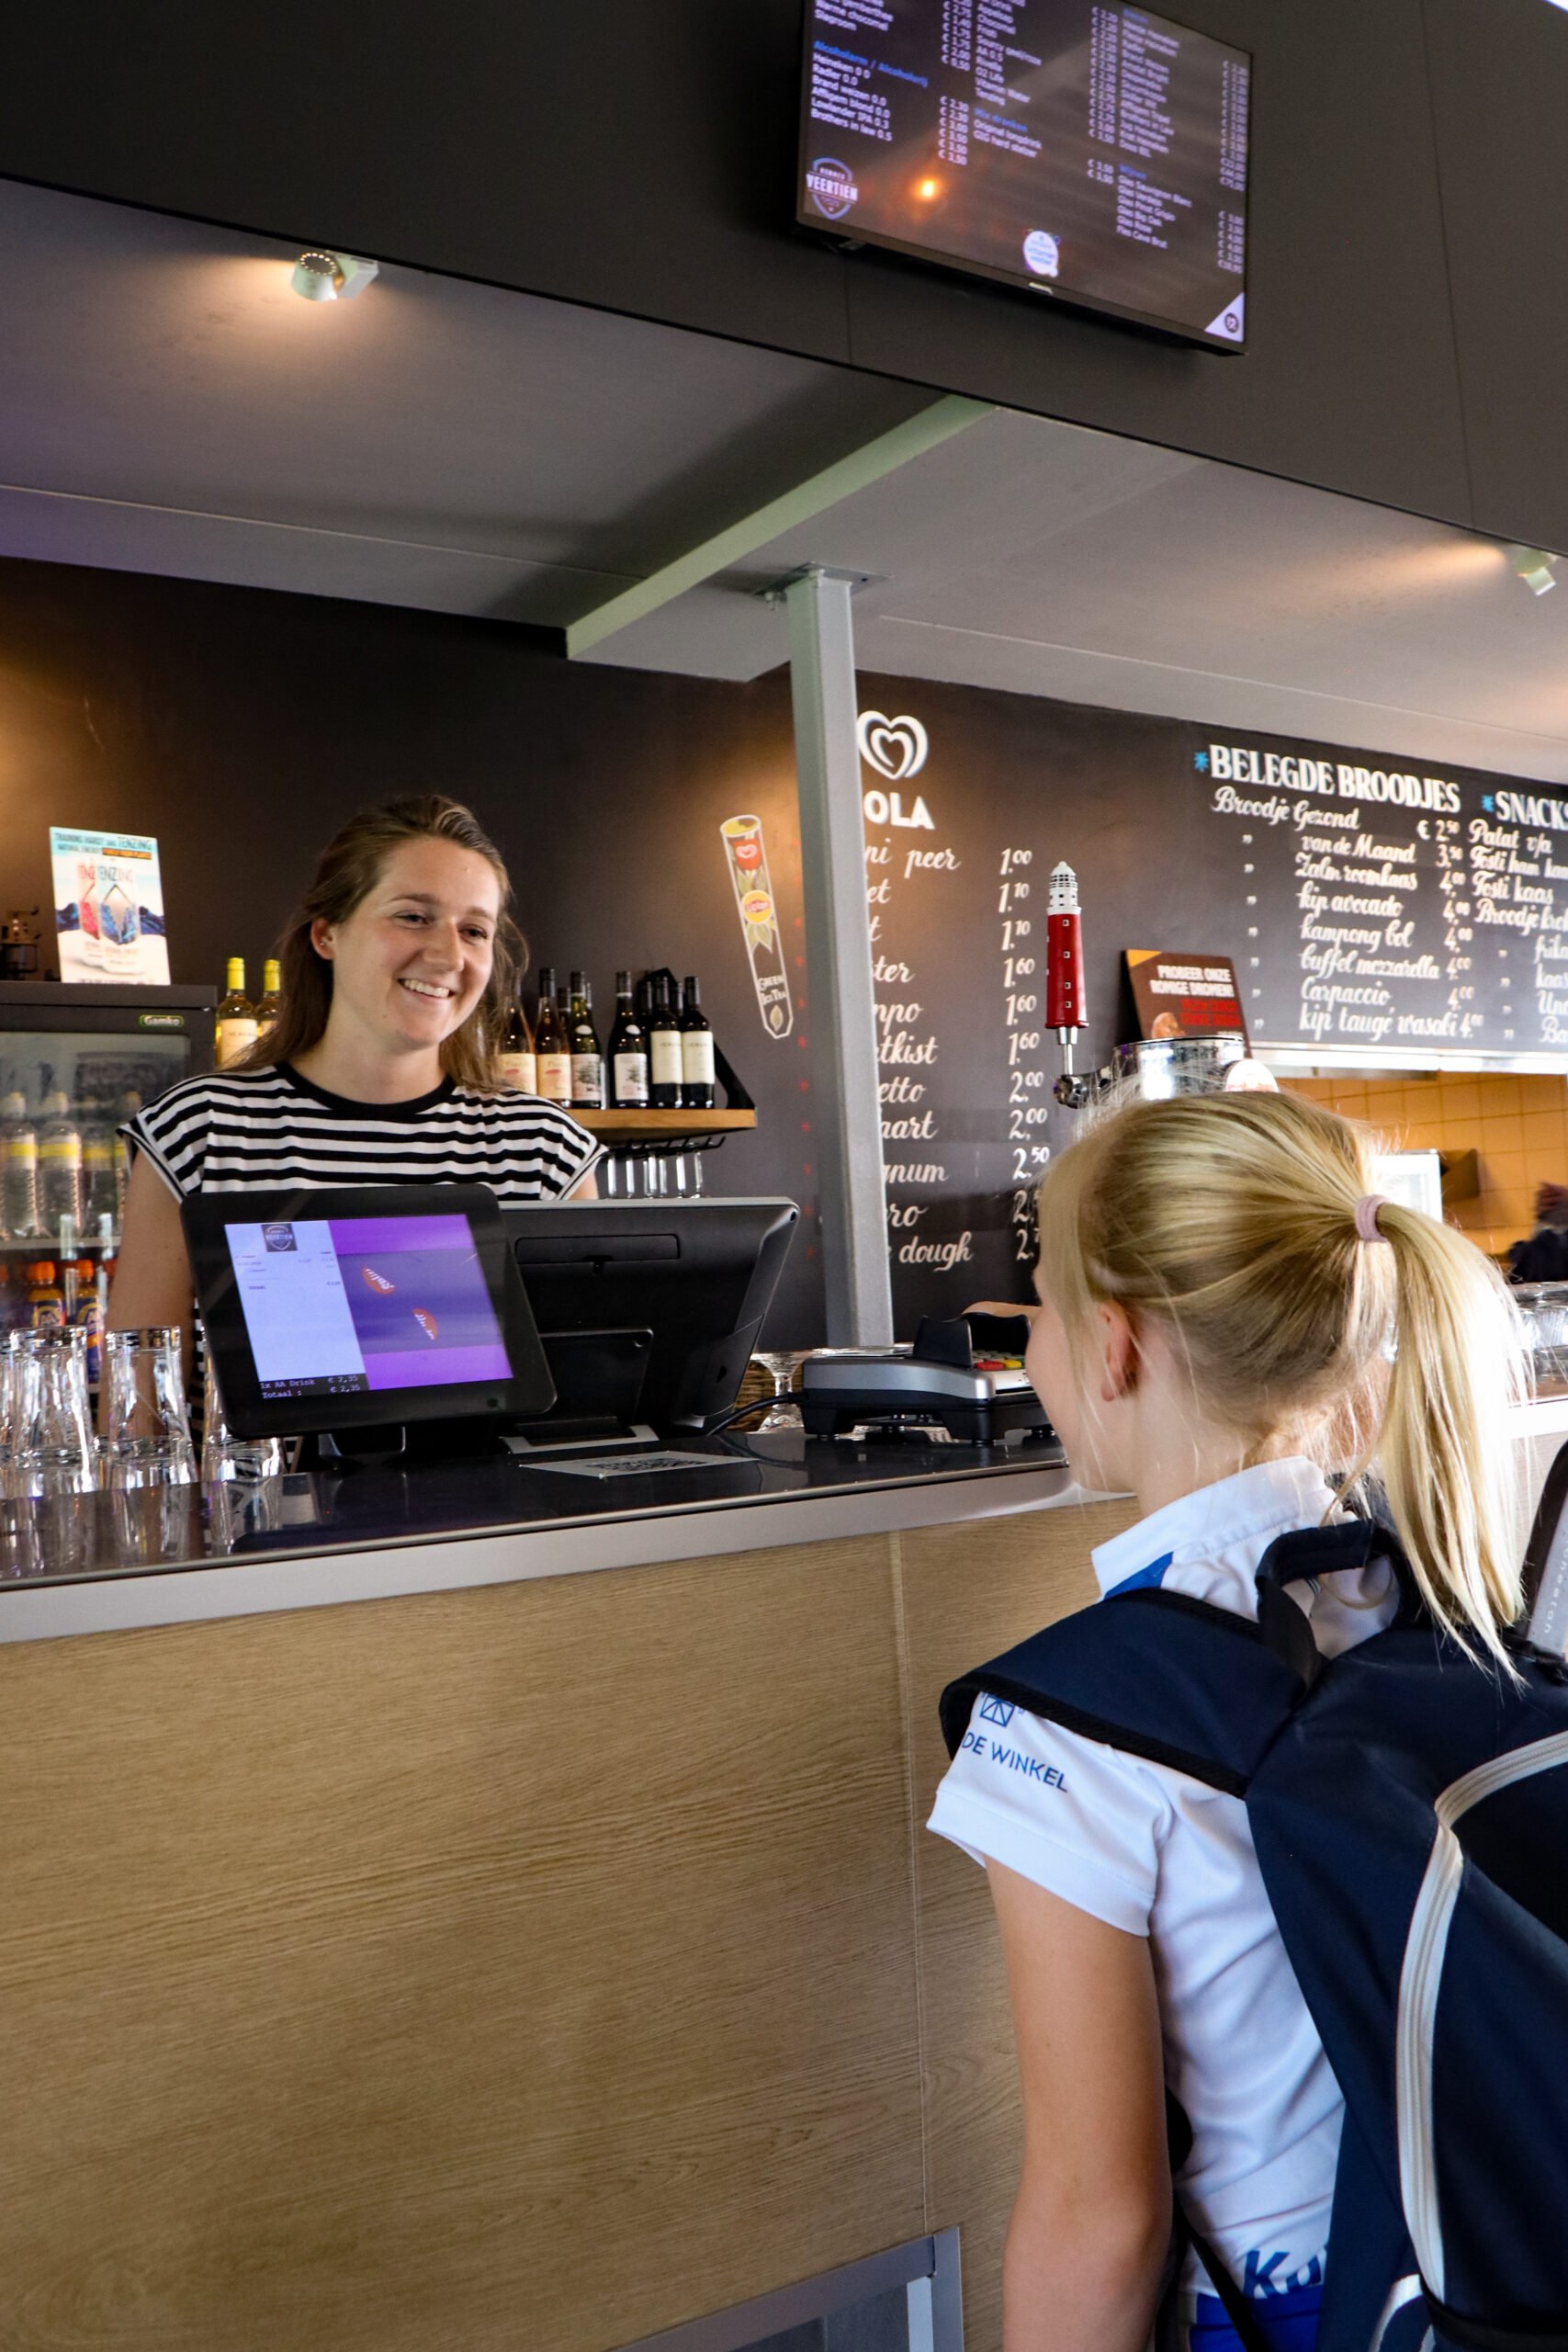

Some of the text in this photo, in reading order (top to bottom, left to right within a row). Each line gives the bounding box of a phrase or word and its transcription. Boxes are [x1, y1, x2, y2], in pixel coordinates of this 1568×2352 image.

[807, 173, 858, 201] VEERTIEN
[1210, 744, 1461, 813] BELEGDE BROODJES
[1210, 786, 1430, 840] Broodje Gezond €
[118, 836, 152, 851] TENZING
[1301, 835, 1332, 852] van
[1334, 837, 1351, 854] de
[1352, 833, 1416, 864] Maand
[1468, 819, 1519, 849] Patat
[904, 848, 963, 879] peer
[1294, 852, 1342, 880] Zalm
[1343, 862, 1417, 890] roomkaas
[1470, 845, 1508, 871] Tosti
[1296, 880, 1328, 918] kip
[1332, 894, 1404, 917] avocado
[1472, 870, 1553, 905] Tosti kaas
[1300, 913, 1382, 954] kampong
[1385, 919, 1415, 947] bol
[1473, 898, 1540, 936] Broodje
[1298, 943, 1359, 979] buffel
[1355, 955, 1440, 980] mozzarella
[1301, 976, 1392, 1012] Carpaccio
[1299, 1002, 1332, 1041] kip
[1397, 1012, 1459, 1037] wasabi
[875, 1031, 939, 1065] tkist
[898, 1231, 974, 1272] dough
[262, 1390, 292, 1399] Totaal
[962, 1731, 1068, 1792] DE WINKEL
